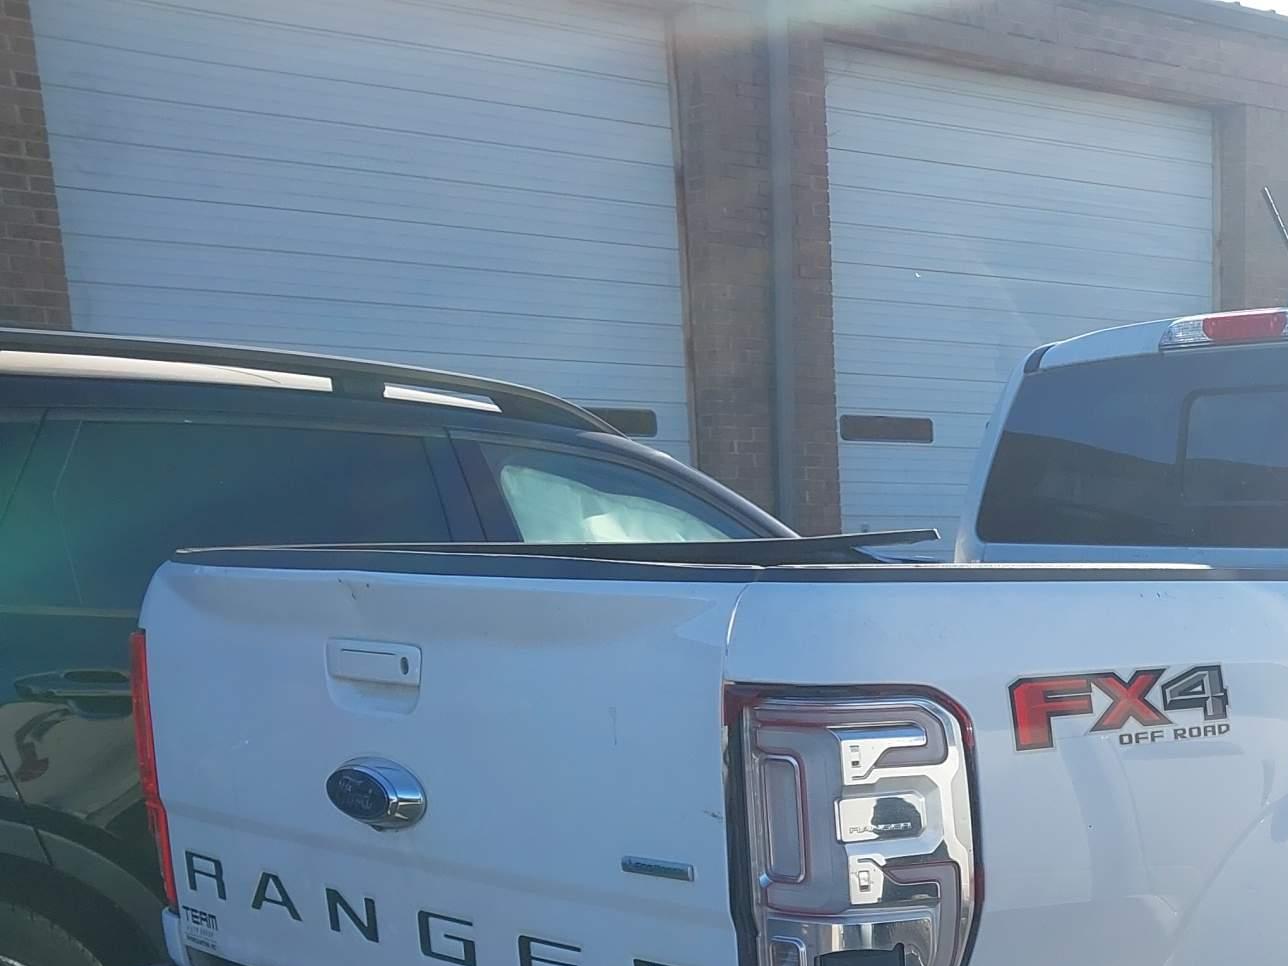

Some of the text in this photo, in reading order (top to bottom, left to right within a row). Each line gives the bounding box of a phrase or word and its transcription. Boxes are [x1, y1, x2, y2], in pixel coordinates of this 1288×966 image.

[1008, 664, 1229, 751] FX4
[1119, 724, 1230, 745] OFF ROAD
[848, 822, 912, 834] RANGER
